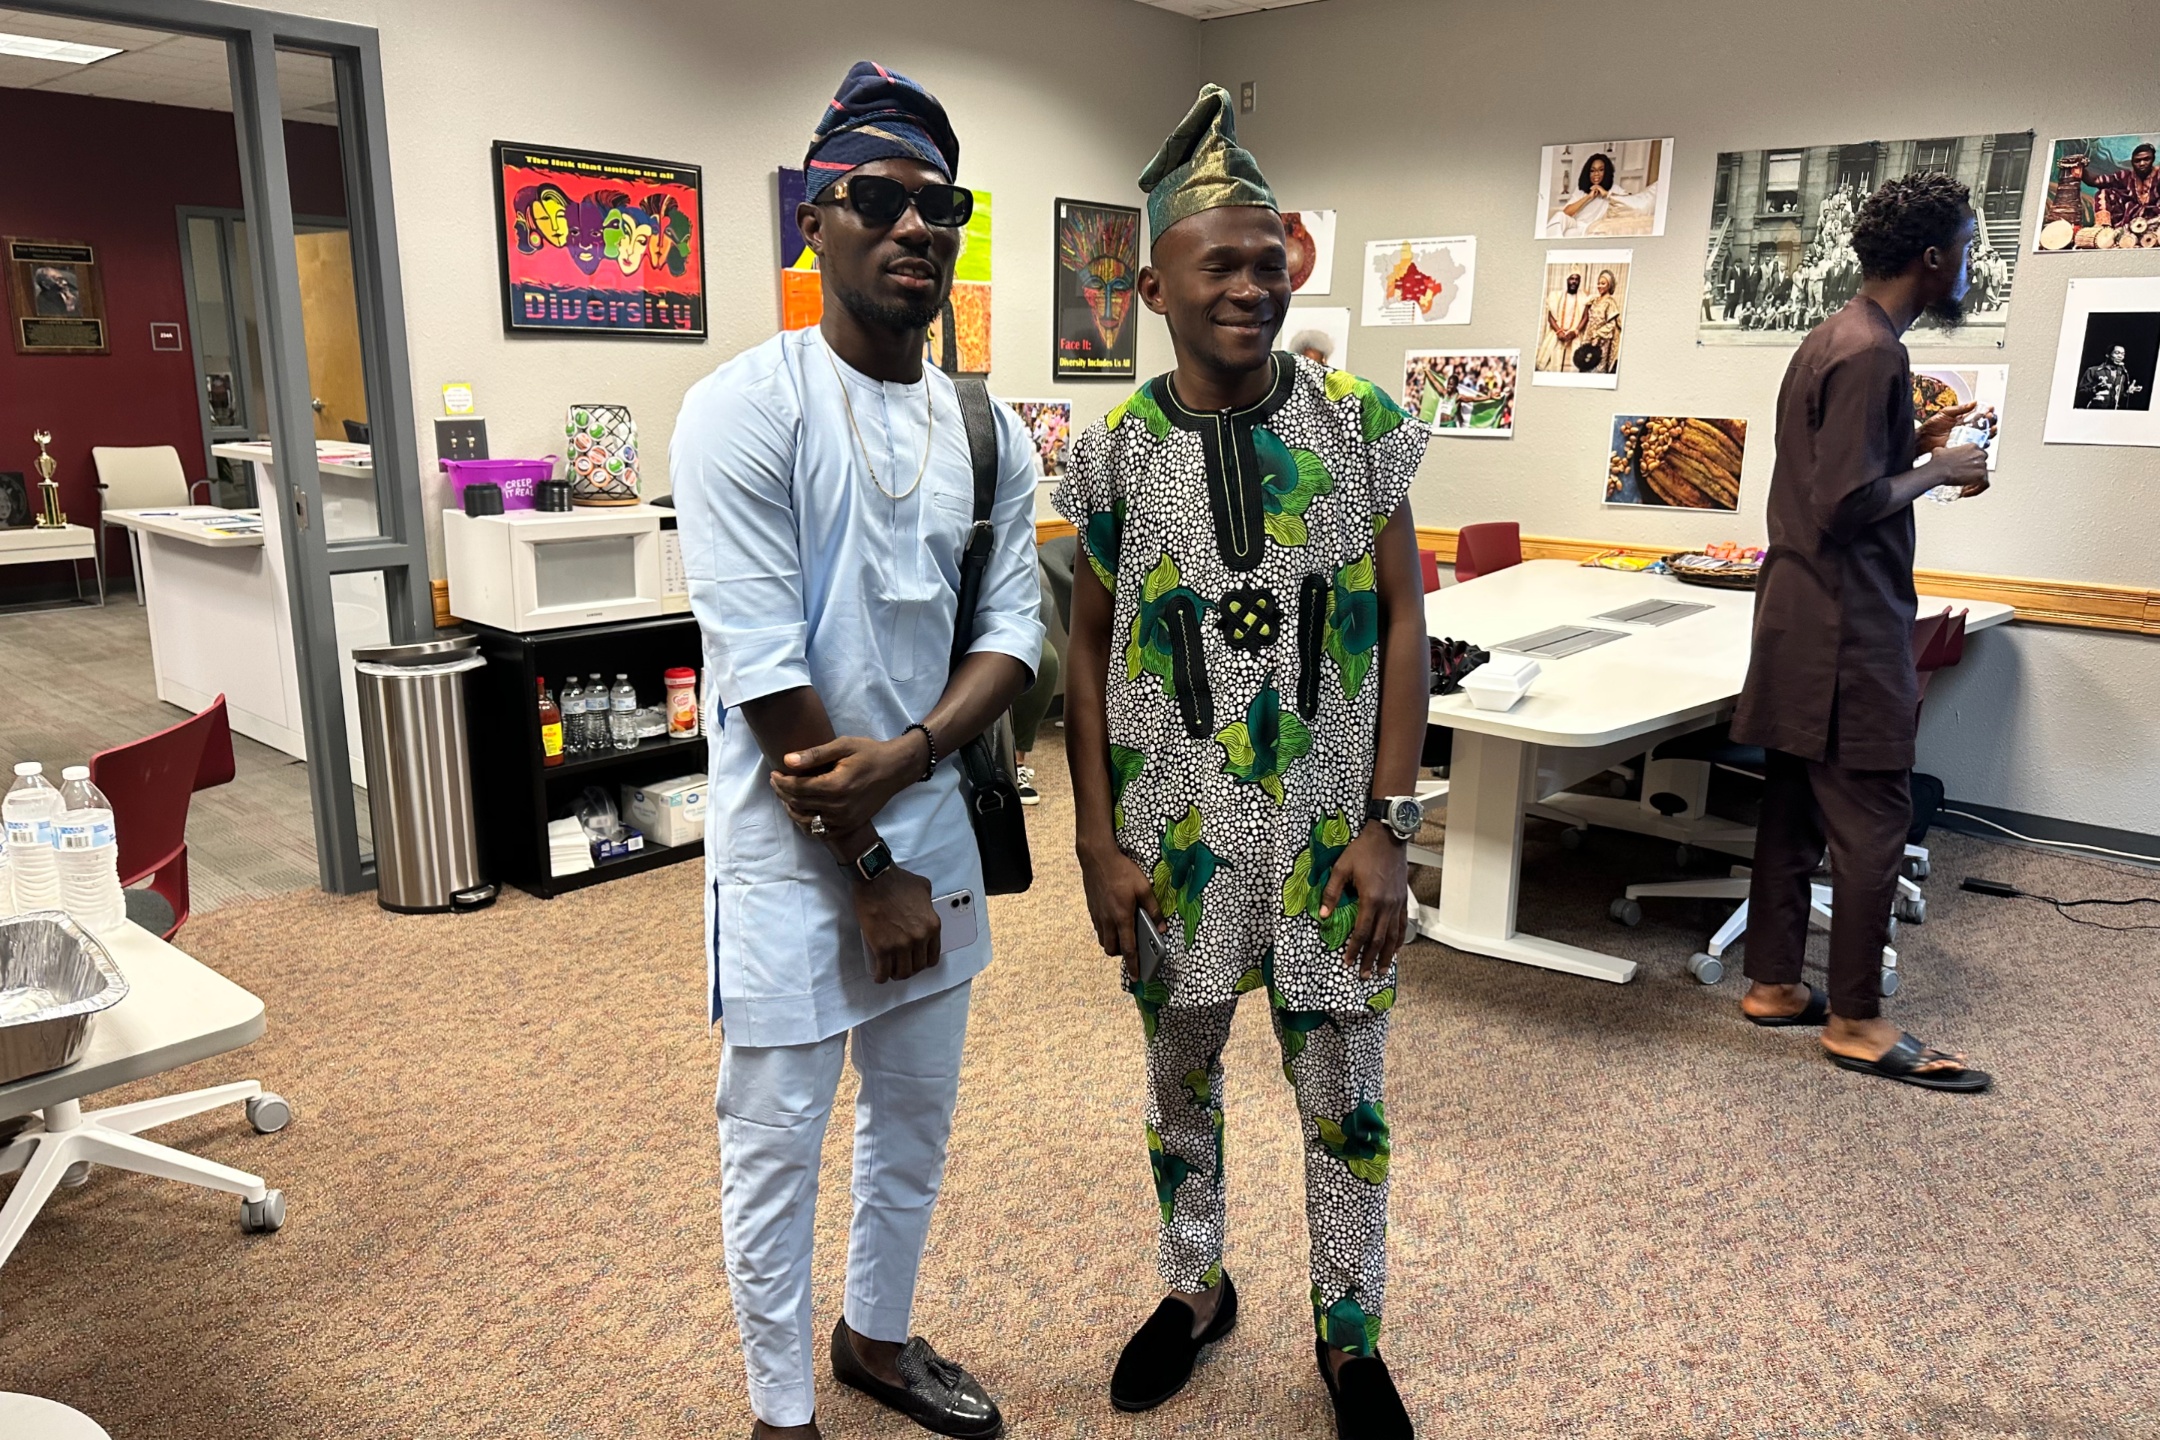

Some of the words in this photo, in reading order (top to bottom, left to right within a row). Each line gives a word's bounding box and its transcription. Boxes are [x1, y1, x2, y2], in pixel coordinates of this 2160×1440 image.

[525, 155, 549, 165] The
[551, 158, 575, 168] link
[577, 161, 602, 171] that
[604, 166, 641, 176] unites
[643, 170, 658, 178] us
[524, 292, 691, 330] Diversity
[1060, 338, 1080, 349] Face
[1082, 339, 1092, 350] It:
[1059, 357, 1086, 368] Diversity
[1087, 358, 1113, 367] Includes
[1114, 358, 1121, 367] Us
[506, 490, 513, 498] IT
[515, 488, 534, 496] REAL
